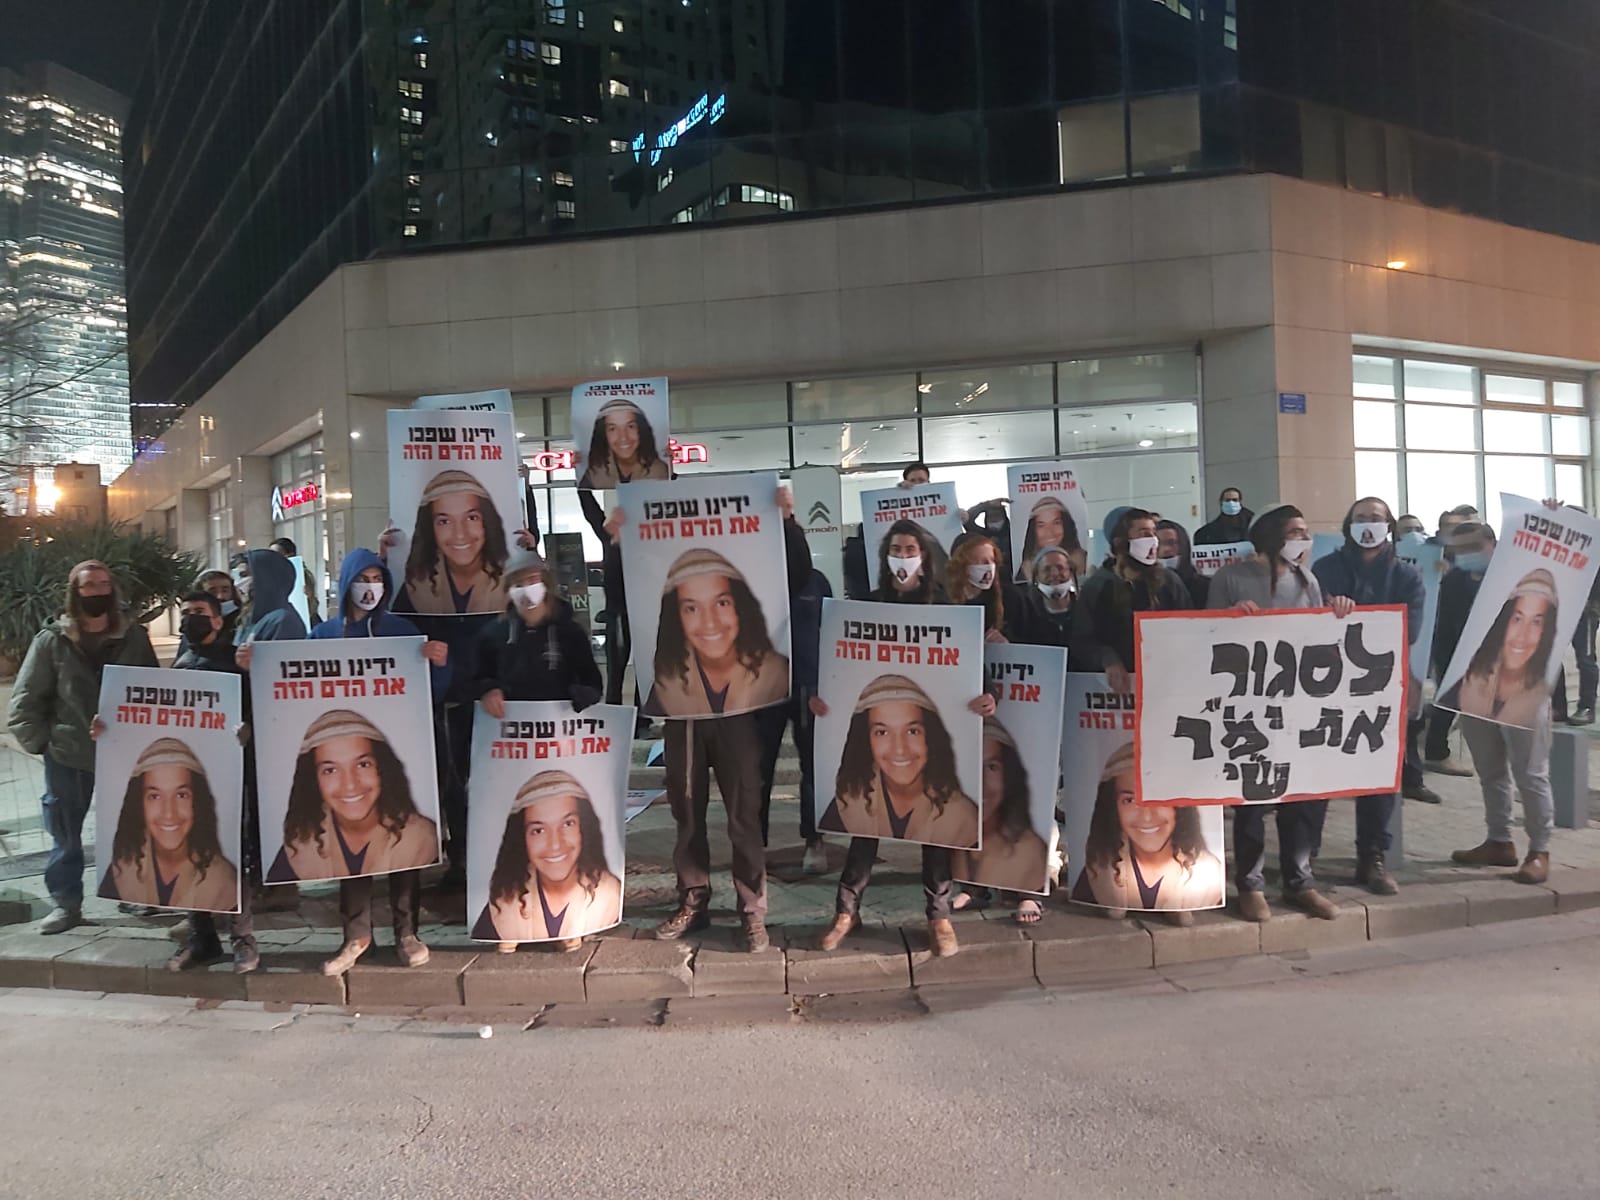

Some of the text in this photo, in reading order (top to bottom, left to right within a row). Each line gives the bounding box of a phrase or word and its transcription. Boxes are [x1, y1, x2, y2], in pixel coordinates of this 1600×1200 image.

[408, 426, 495, 442] ידינו שפכו
[403, 444, 502, 460] את הדם הזה
[1021, 470, 1073, 482] ידינו שפכו
[1018, 481, 1076, 493] את הדם הזה
[643, 495, 750, 520] ידינו שפכו
[877, 493, 941, 510] ידינו שפכו
[874, 504, 947, 523] את הדם הזה
[638, 514, 760, 541] את הדם הזה
[1524, 513, 1593, 550] ידינו שפכו
[1211, 547, 1237, 557] ידינו
[1513, 529, 1589, 569] את הדם הזה
[844, 620, 952, 644] ידינו שפכו
[835, 640, 960, 666] את הדם הזה
[1211, 622, 1395, 698] לסגור
[280, 657, 395, 679] ידינו שפכו
[991, 661, 1034, 681] ידינו
[125, 686, 220, 708] ידינו שפכו
[273, 677, 406, 700] את הדם הזה
[1009, 683, 1040, 702] את
[117, 705, 226, 730] את הדם הזה
[562, 719, 605, 736] ידינו
[1079, 711, 1115, 730] הזה
[1299, 705, 1391, 754] את
[491, 741, 528, 760] הזה
[581, 737, 610, 754] את
